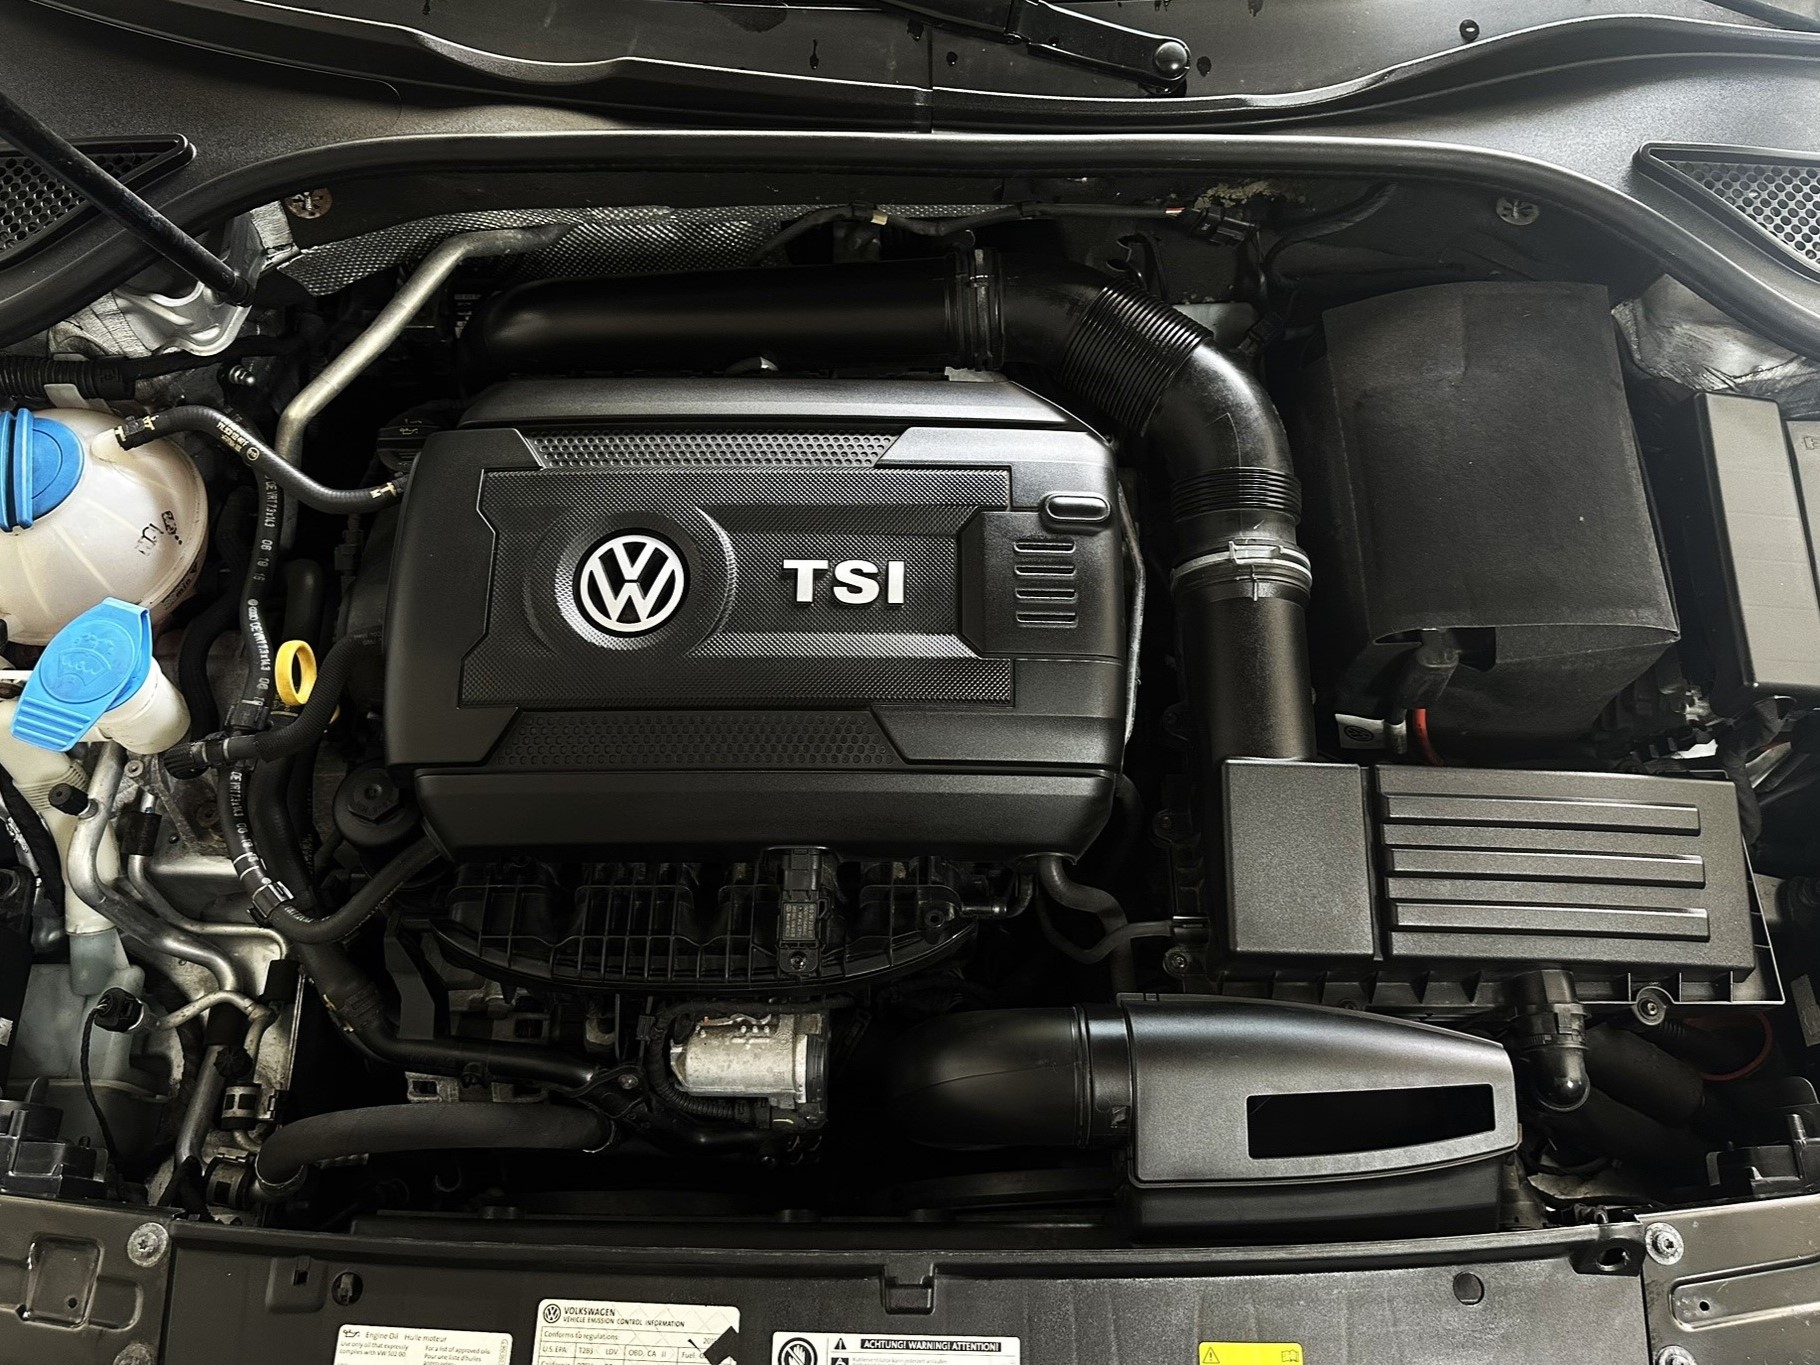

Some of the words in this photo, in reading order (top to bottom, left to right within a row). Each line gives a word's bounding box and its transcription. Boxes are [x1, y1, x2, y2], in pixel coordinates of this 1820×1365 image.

[782, 558, 905, 606] TSI
[564, 1307, 616, 1316] VOLKSWAGEN
[616, 1318, 643, 1326] CONTROL
[645, 1319, 685, 1327] INFORMATION
[365, 1331, 388, 1341] Engine
[389, 1332, 399, 1340] Oil
[544, 1330, 574, 1338] Conforms
[863, 1340, 906, 1349] ACHTUNG!
[908, 1341, 950, 1350] WARNING!
[951, 1341, 999, 1351] ATTENTION!
